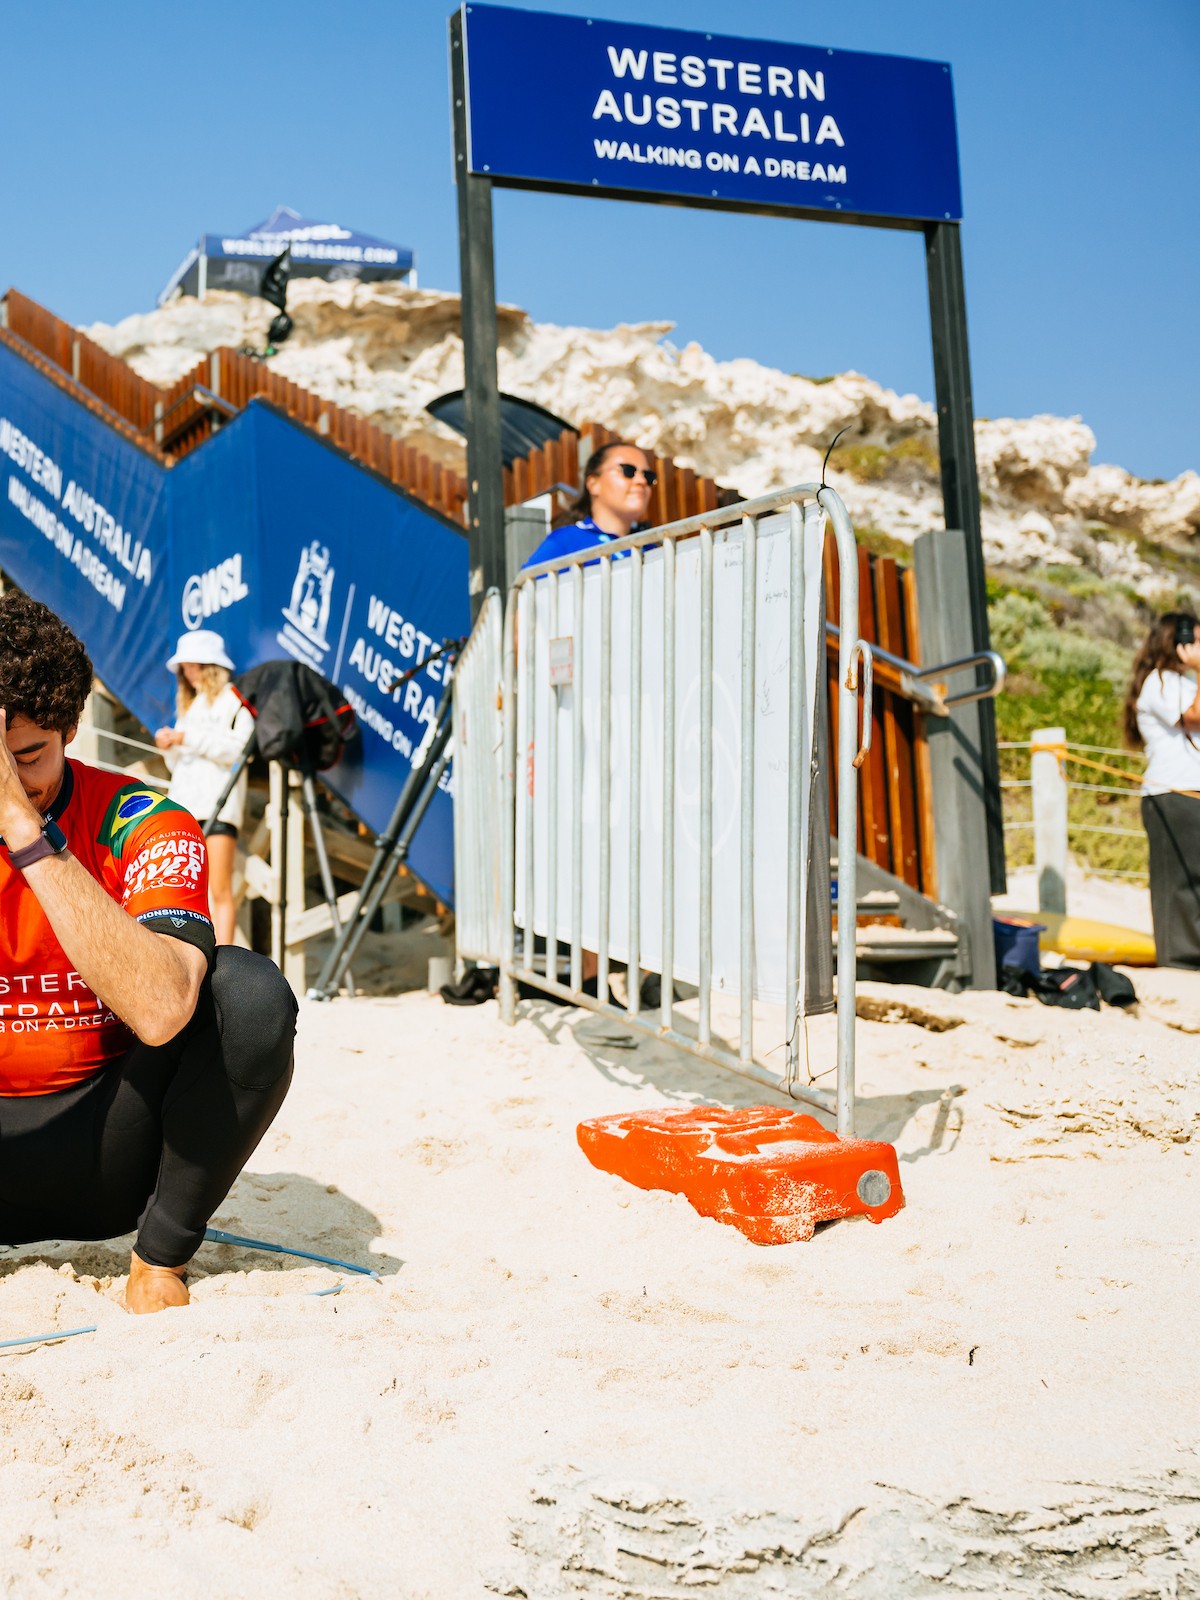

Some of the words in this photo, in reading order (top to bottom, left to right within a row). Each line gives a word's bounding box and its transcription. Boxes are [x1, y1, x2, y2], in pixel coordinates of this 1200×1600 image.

[607, 45, 826, 102] WESTERN
[592, 89, 845, 148] AUSTRALIA
[593, 138, 702, 170] WALKING
[706, 151, 740, 174] ON
[743, 155, 763, 177] A
[764, 157, 848, 184] DREAM
[8, 475, 57, 541] WALKING
[61, 479, 152, 588] AUSTRALIA
[367, 594, 455, 687] WESTE
[348, 637, 440, 726] AUSTRA
[136, 909, 187, 922] PIONSHIP
[187, 911, 211, 925] TOUR
[11, 1018, 40, 1033] ON
[45, 1019, 59, 1031] A
[64, 1012, 120, 1029] DREA
